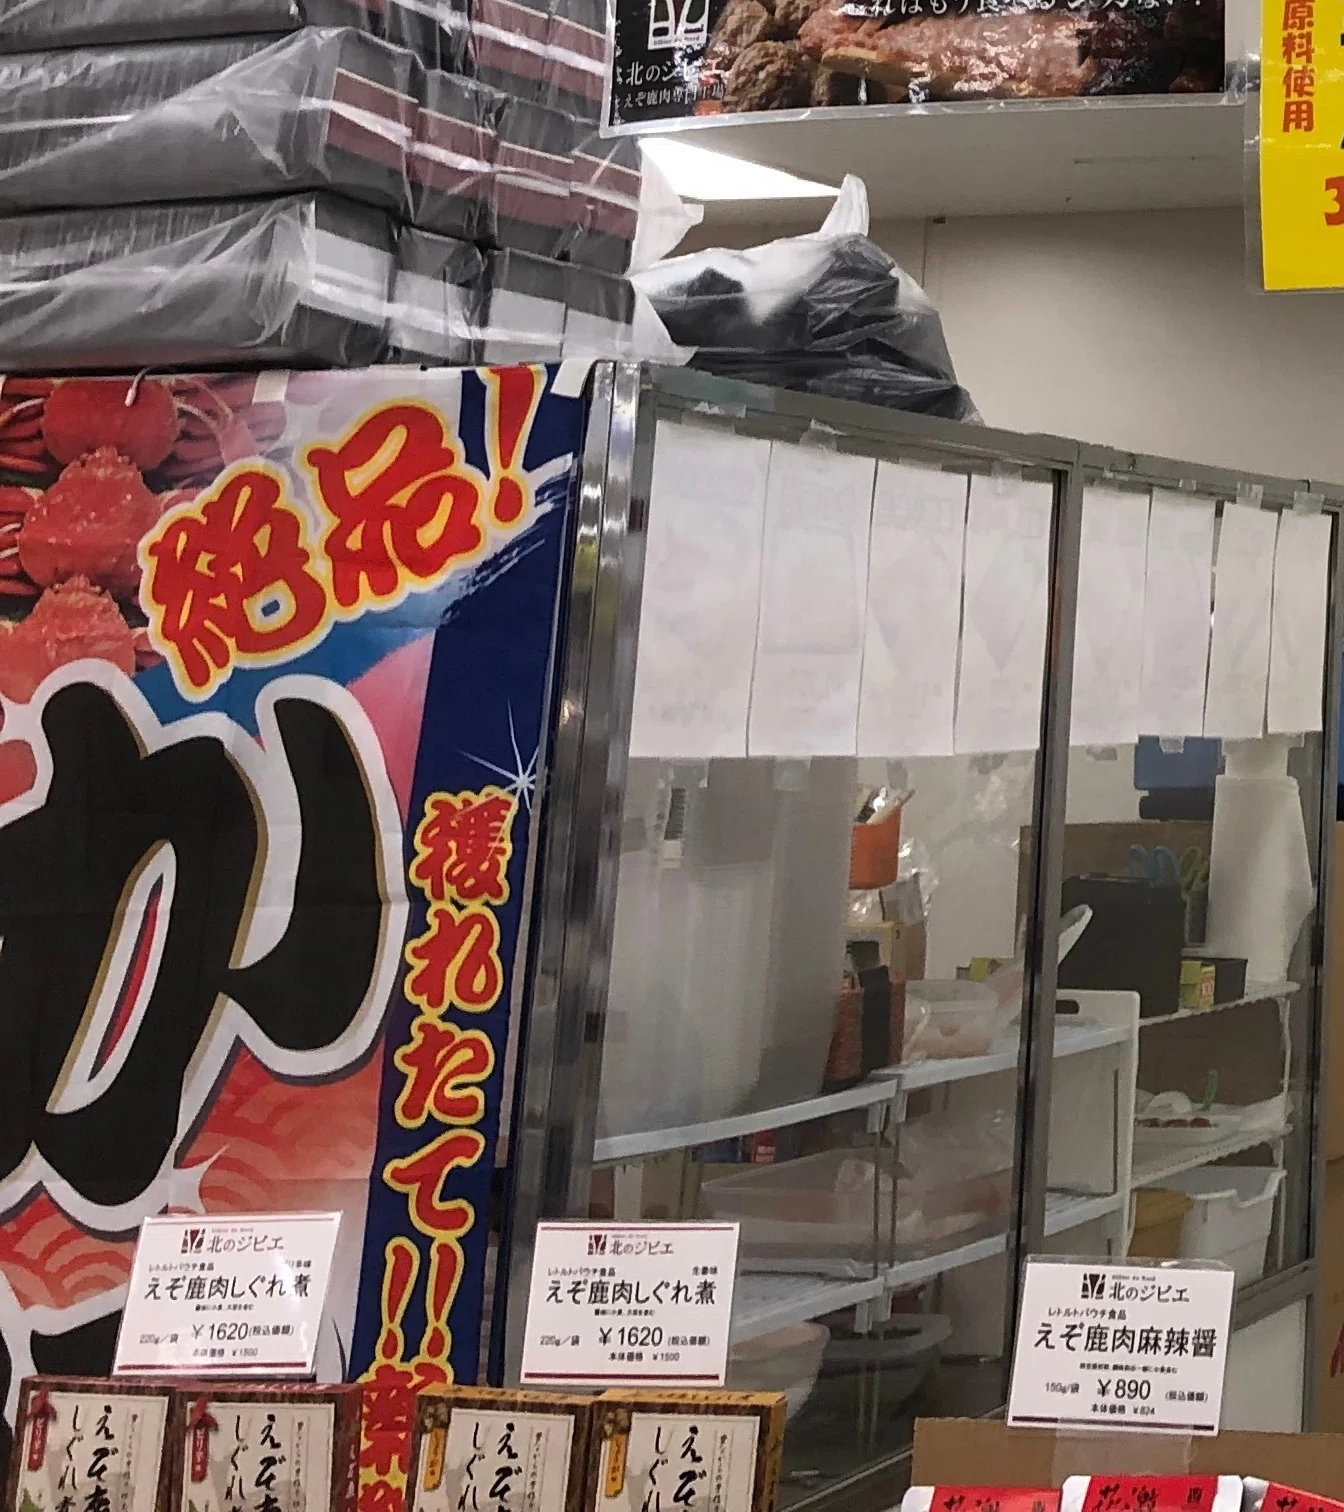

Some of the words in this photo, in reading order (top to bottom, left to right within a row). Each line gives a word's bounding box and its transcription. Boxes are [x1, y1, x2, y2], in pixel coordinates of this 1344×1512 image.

[207, 1235, 284, 1253] 北のジビエ
[609, 1239, 674, 1256] 北のジビエ
[144, 1273, 312, 1301] えぞ鹿肉しぐれ煮
[545, 1279, 717, 1306] えぞ鹿肉しぐれ煮
[1107, 1281, 1190, 1304] 北のジビエ
[1047, 1307, 1128, 1321] レトルトパウチ食品
